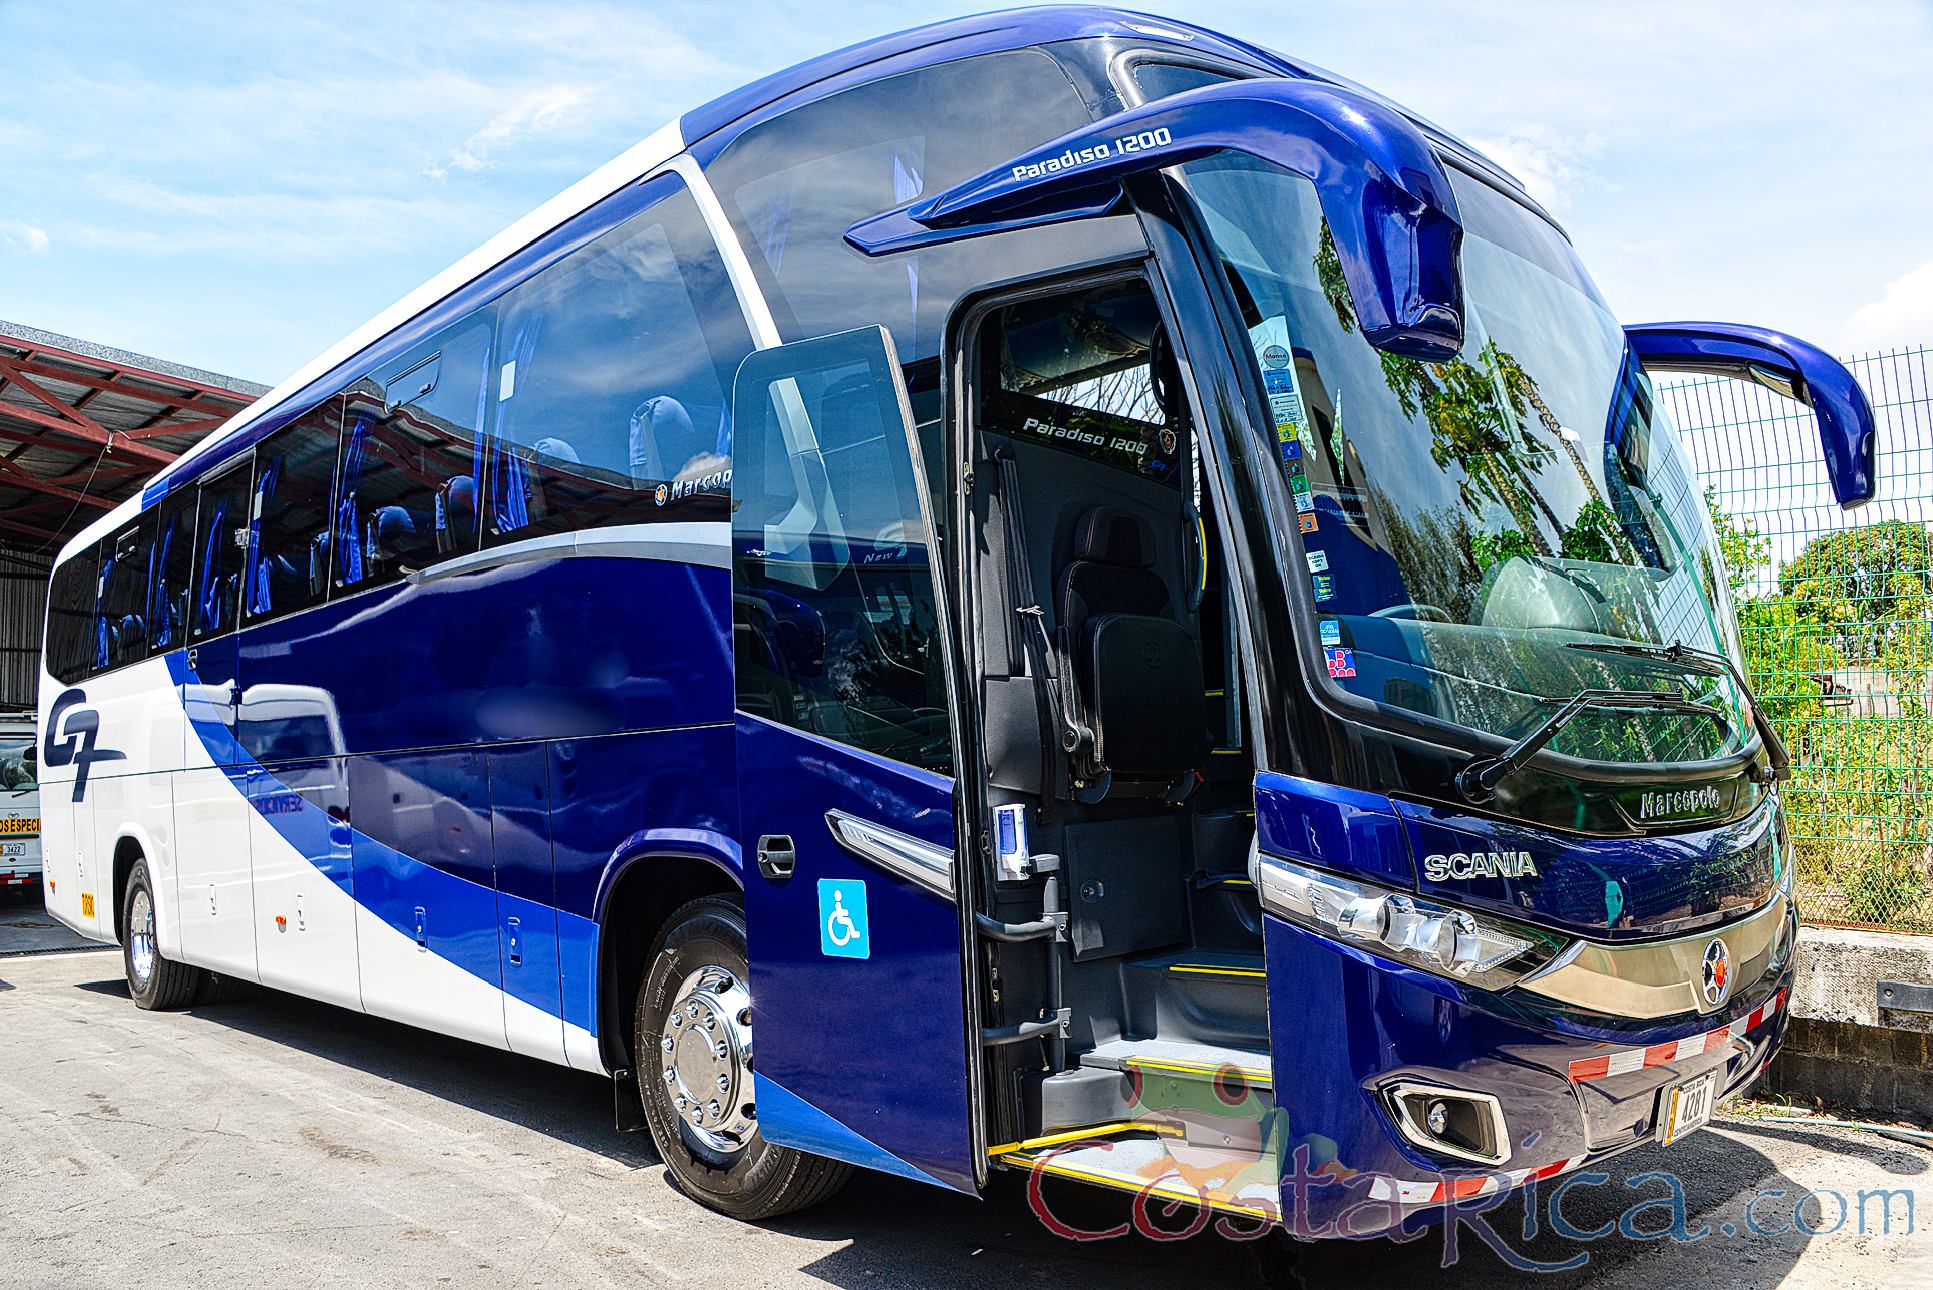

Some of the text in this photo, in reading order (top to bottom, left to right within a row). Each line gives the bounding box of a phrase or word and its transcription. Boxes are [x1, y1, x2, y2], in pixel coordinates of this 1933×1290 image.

[1012, 127, 1173, 182] Paradiso 1200
[1022, 417, 1149, 454] Paradiso 1200
[1640, 785, 1720, 819] Marcopolo
[1424, 851, 1538, 882] SCANIA
[1682, 1086, 1707, 1123] 4281
